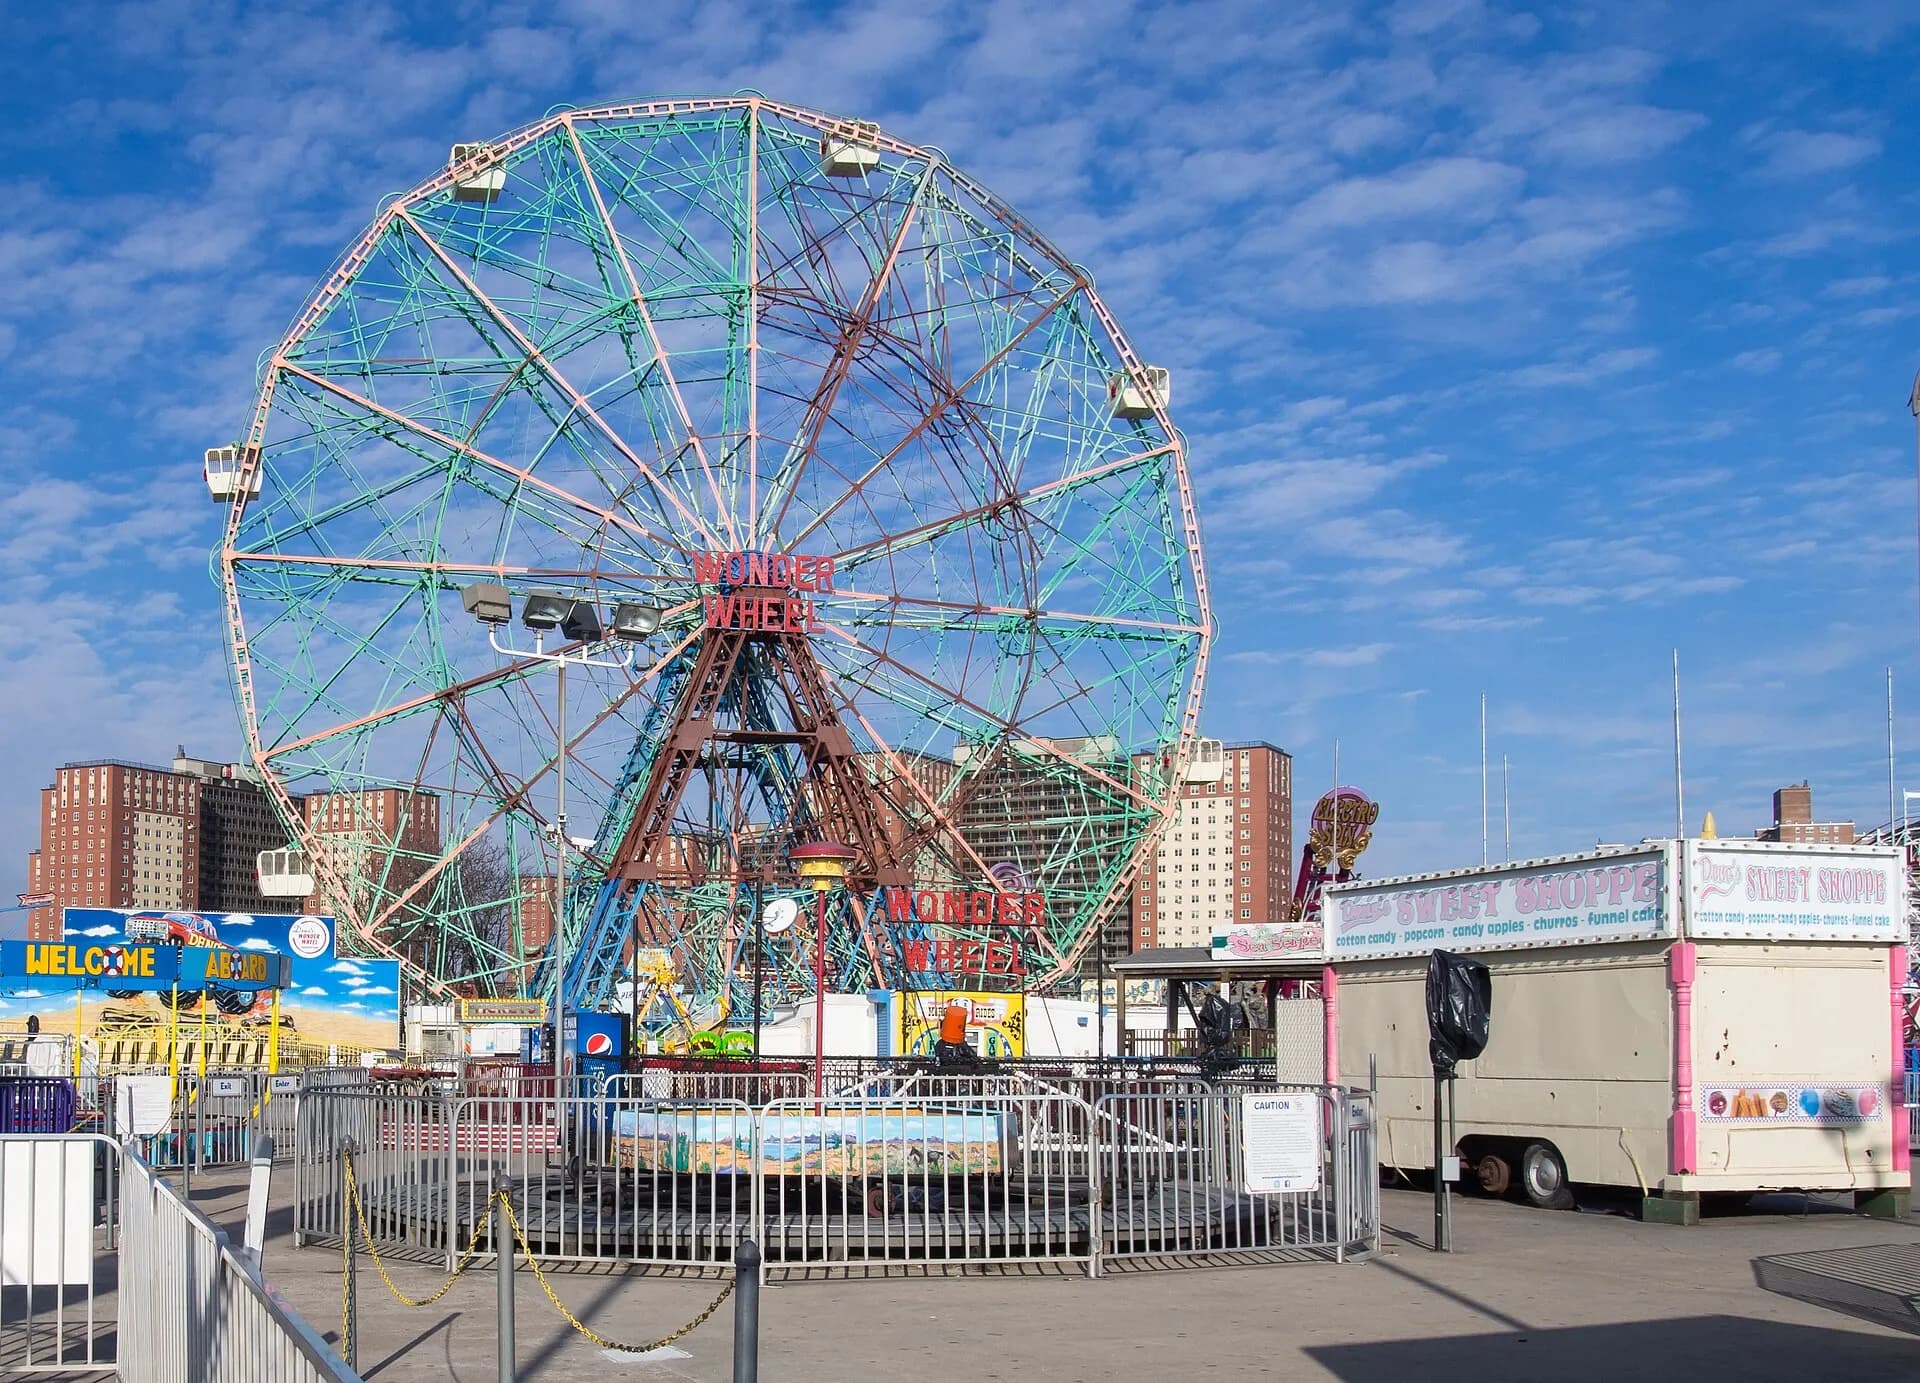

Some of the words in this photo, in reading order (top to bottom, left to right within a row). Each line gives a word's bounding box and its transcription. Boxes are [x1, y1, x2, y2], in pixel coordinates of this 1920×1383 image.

[692, 551, 834, 592] WONDER
[704, 596, 826, 633] WHEEL
[1316, 798, 1379, 826] ELECTRO
[1322, 825, 1357, 848] SPIN
[1396, 882, 1502, 926] SWEET
[1515, 863, 1659, 915] SHOPPE
[1746, 865, 1811, 902] SWEET
[1817, 867, 1887, 904] SHOPPE
[887, 889, 1046, 926] WONDER
[1700, 912, 1723, 923] cotton
[1725, 912, 1745, 924] candy
[1823, 914, 1848, 926] churros
[1851, 914, 1873, 927] funnel
[1875, 915, 1891, 927] cake
[188, 932, 227, 950] DENO
[1336, 934, 1366, 946] cotton
[1368, 931, 1397, 944] candy
[1404, 927, 1445, 943] popcorn
[1452, 922, 1484, 938] candy
[1488, 919, 1525, 936] apples
[1534, 915, 1578, 931] churros
[1588, 909, 1629, 926] funnel
[1632, 906, 1663, 922] cake
[26, 944, 156, 979] WELCOME
[205, 950, 267, 981] ABOARD
[902, 939, 1028, 975] WHEEL
[219, 1082, 232, 1090] Exit
[1253, 1100, 1290, 1110] CAUTION
